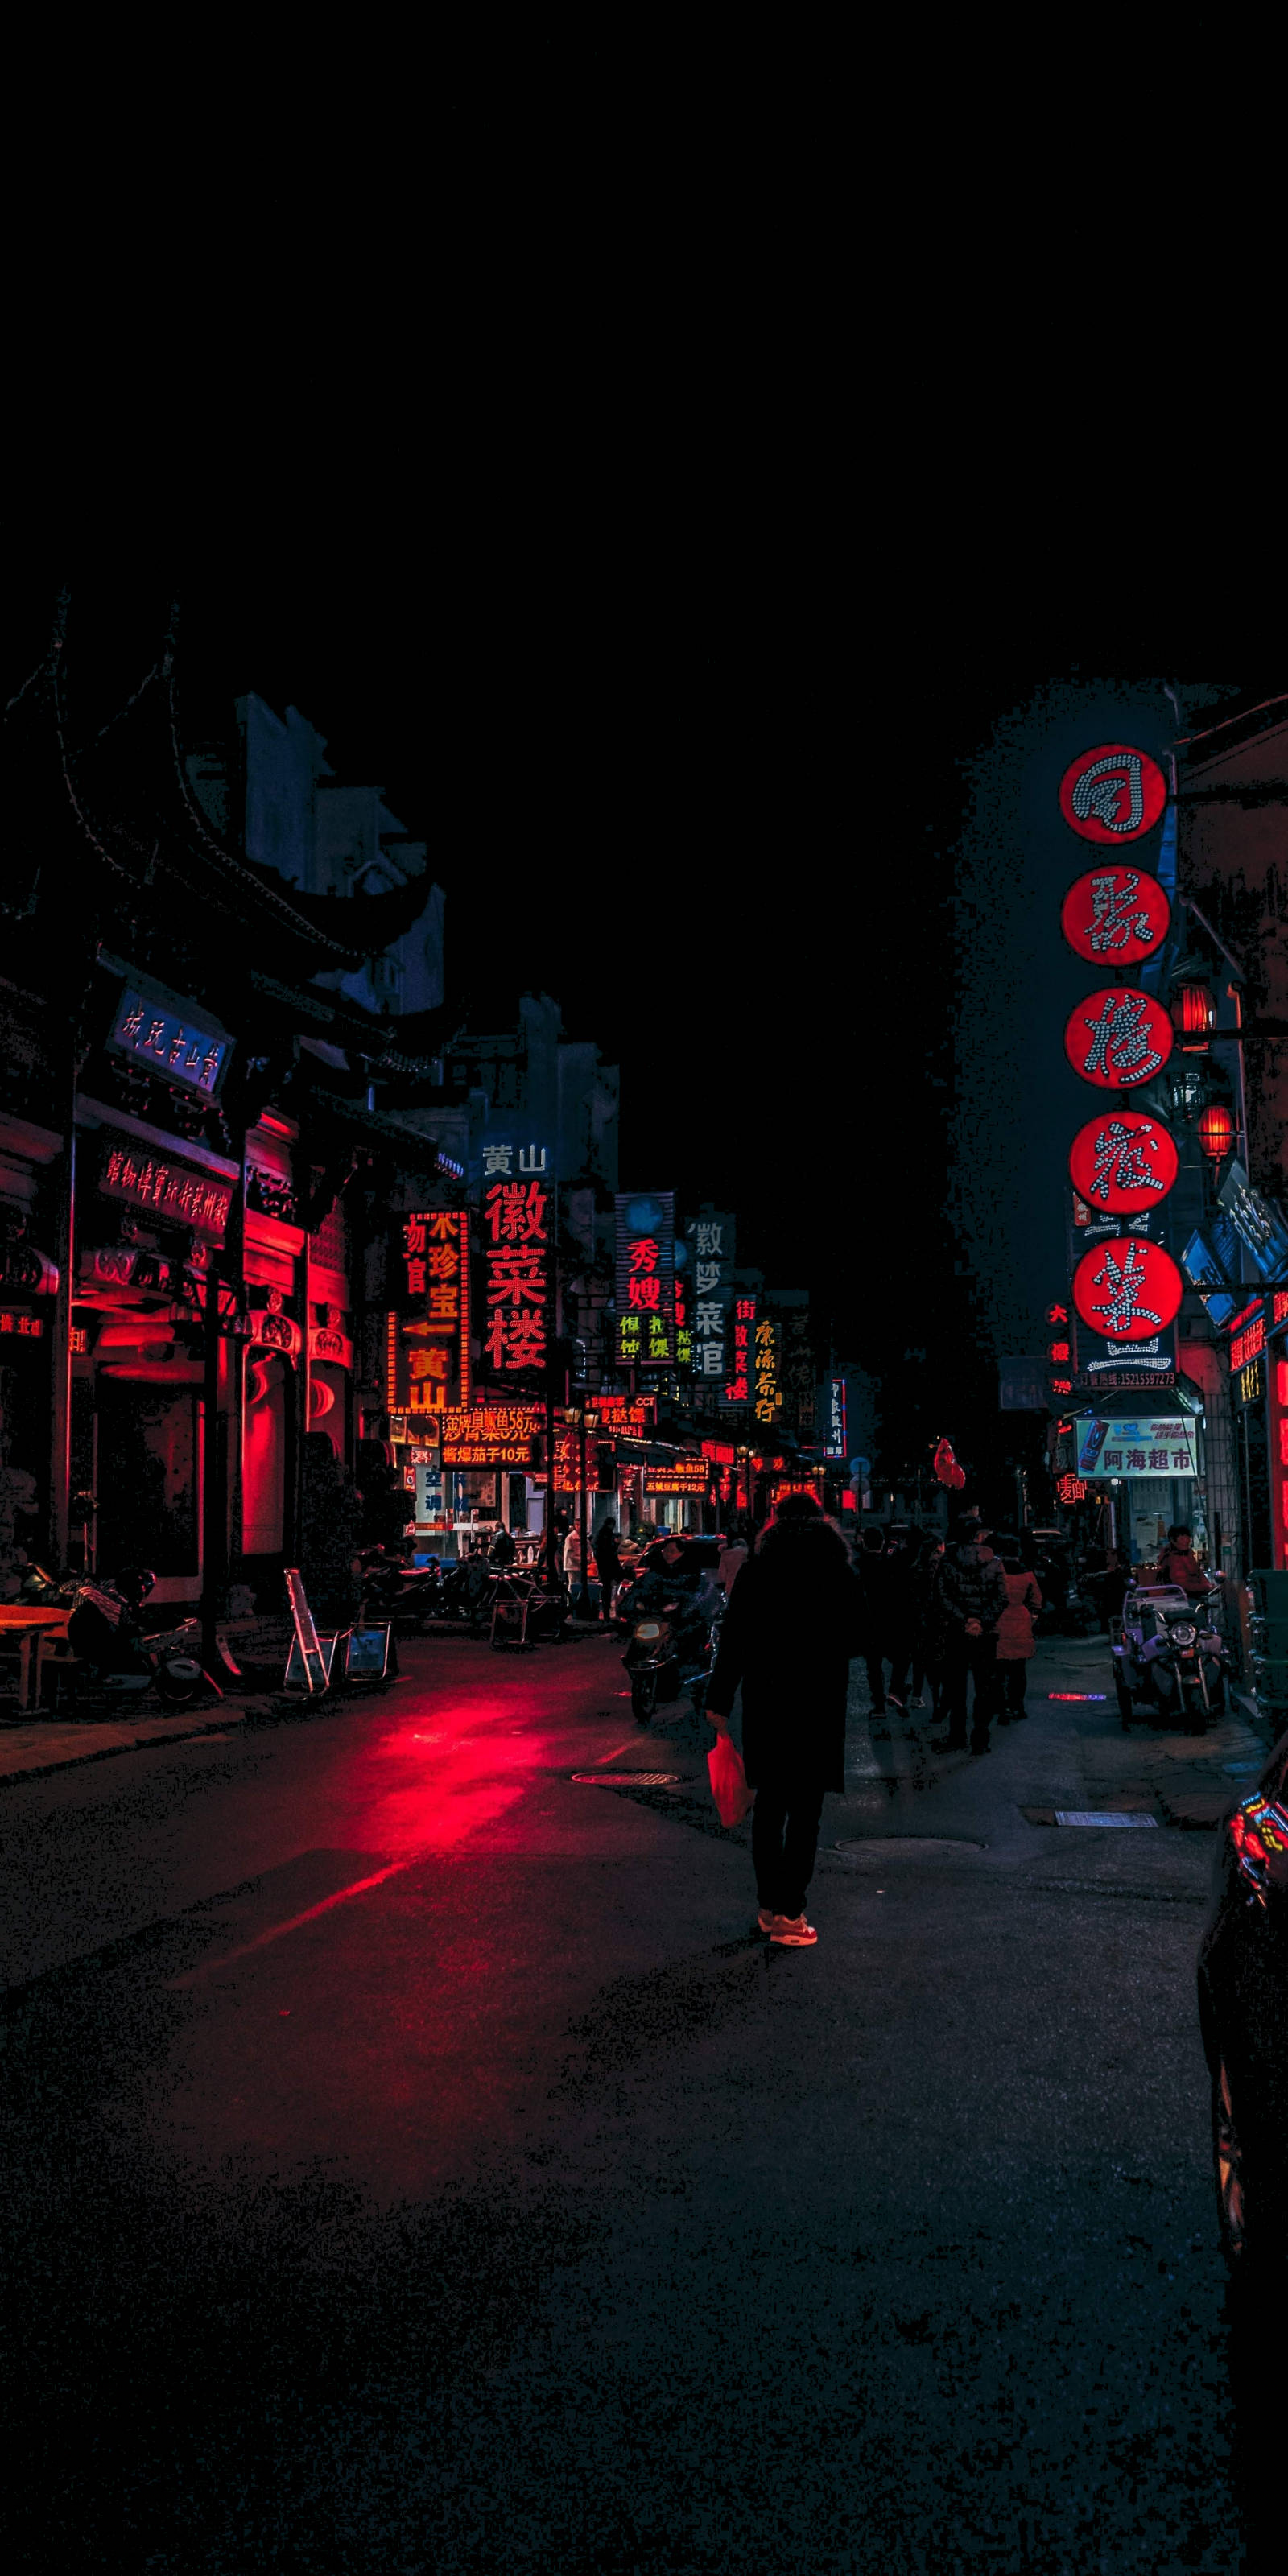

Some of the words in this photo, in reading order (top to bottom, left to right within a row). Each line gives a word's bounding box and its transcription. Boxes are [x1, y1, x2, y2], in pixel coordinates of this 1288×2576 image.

[483, 1144, 546, 1175] 黄山
[485, 1181, 547, 1368] 徽菜楼
[627, 1237, 661, 1311] 秀嫂
[407, 1347, 449, 1410] 黄山
[443, 1446, 530, 1463] 酱爆茄子10元
[1104, 1448, 1191, 1472] 阿海超市
